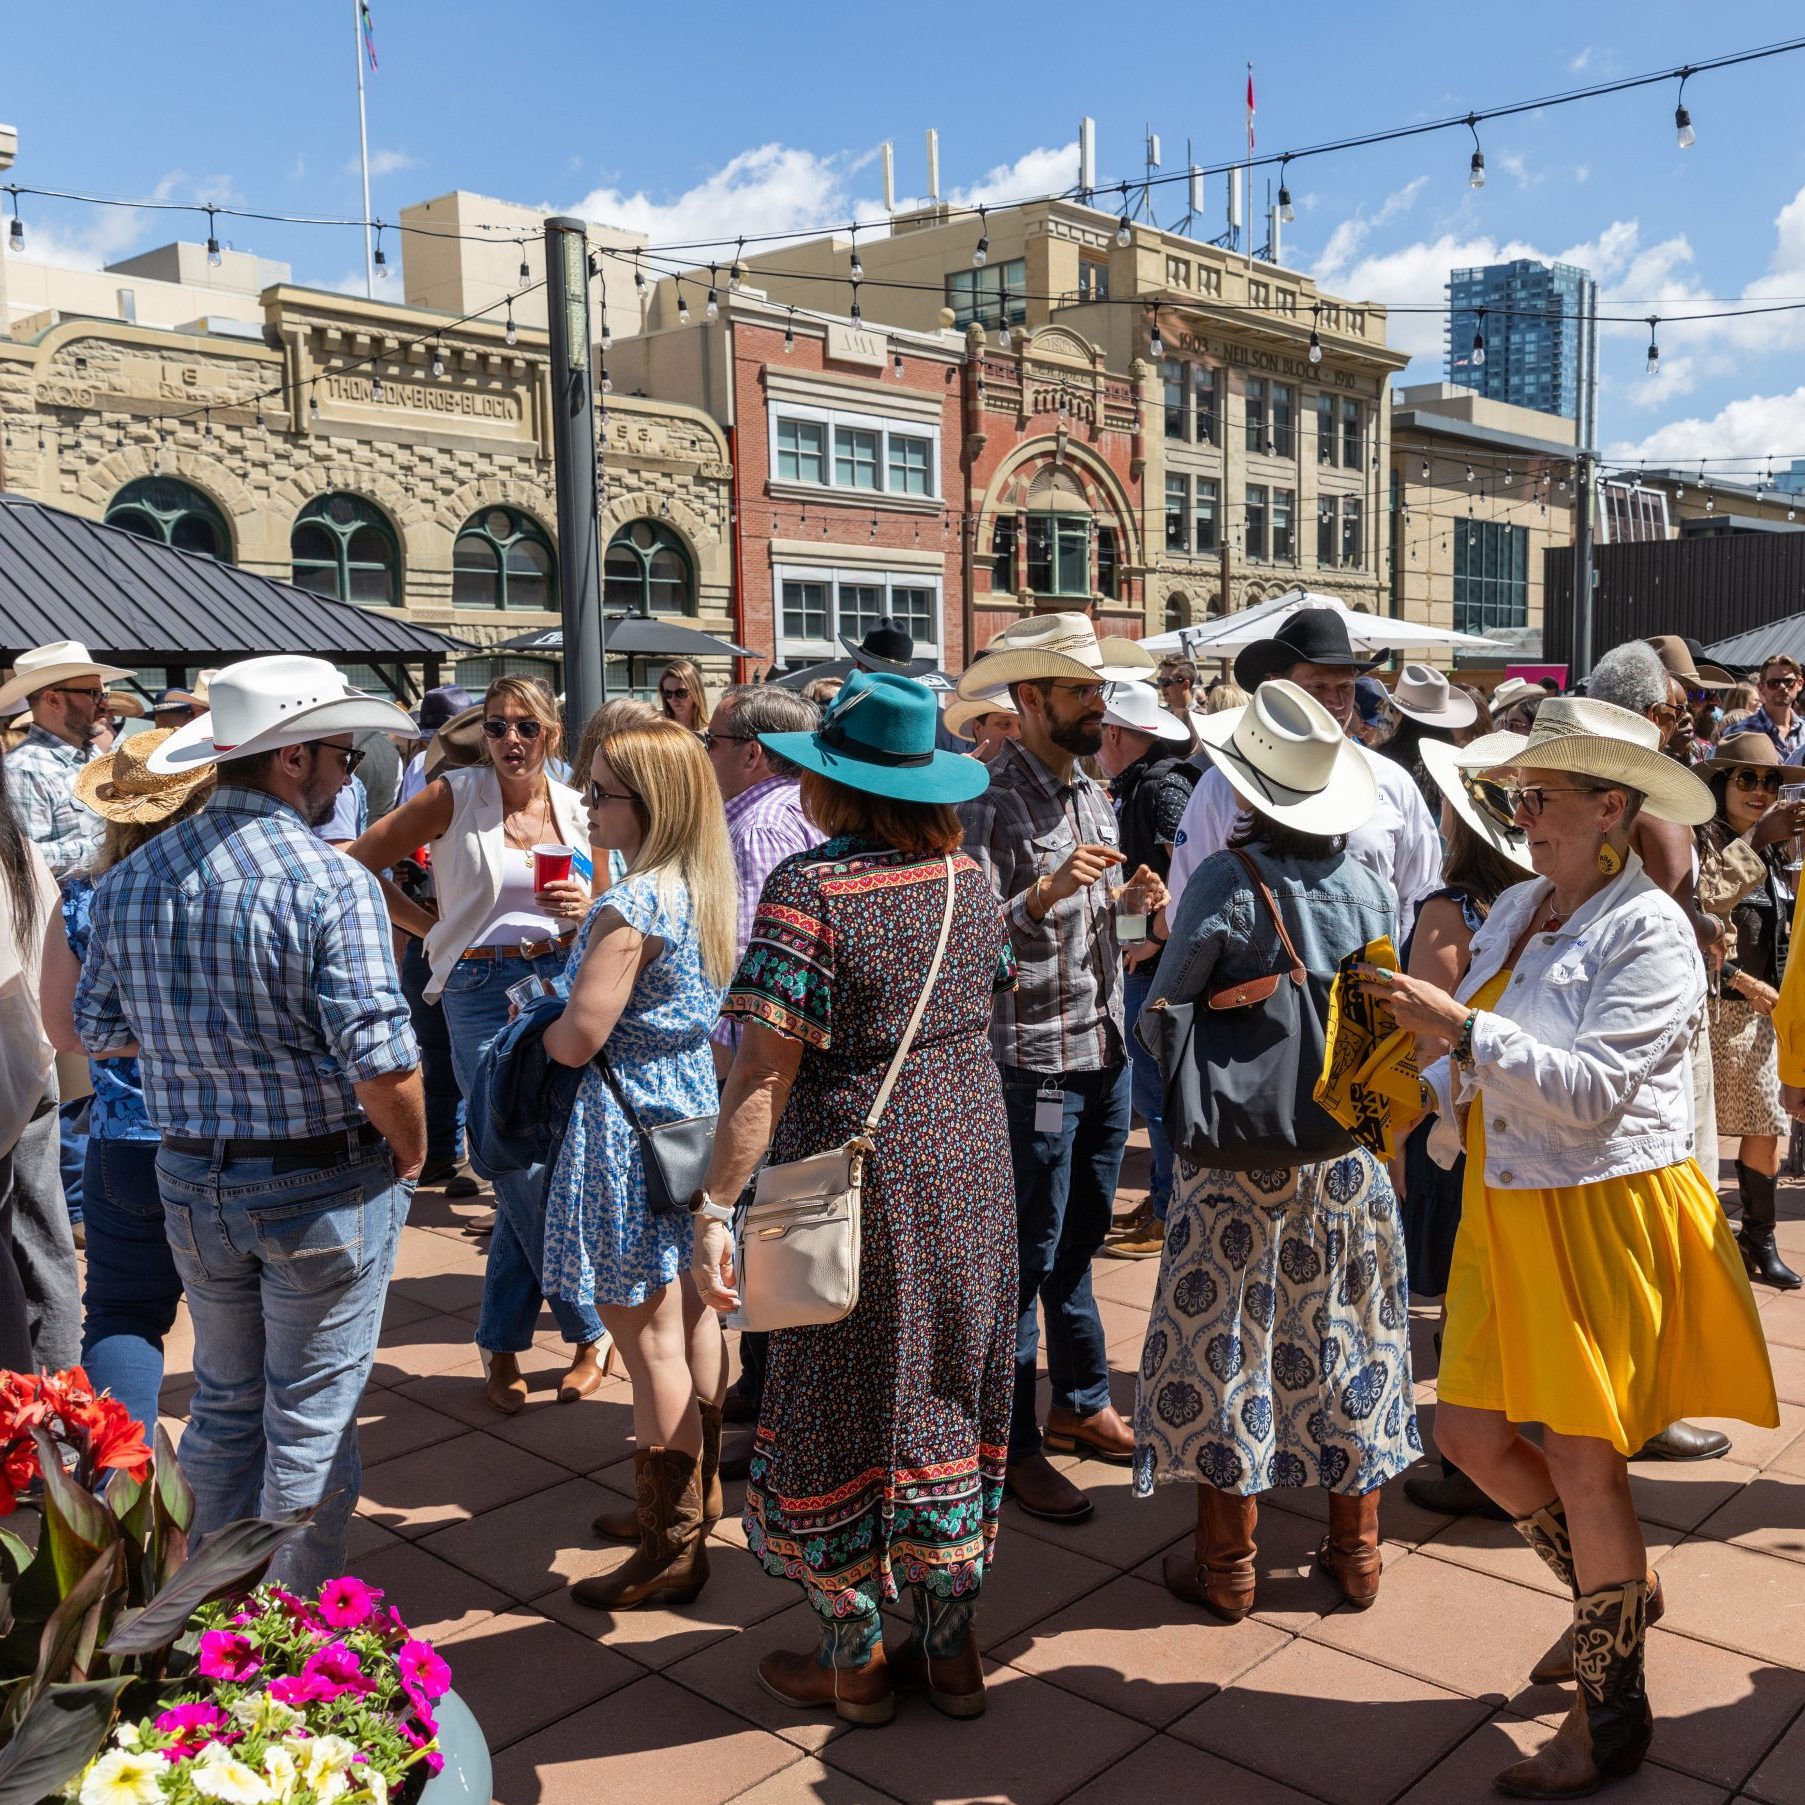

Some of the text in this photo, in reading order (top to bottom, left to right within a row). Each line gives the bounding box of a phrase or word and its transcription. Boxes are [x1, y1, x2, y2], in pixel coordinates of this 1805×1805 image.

[1178, 332, 1356, 389] 1903 NEILSON BLOCK 1910
